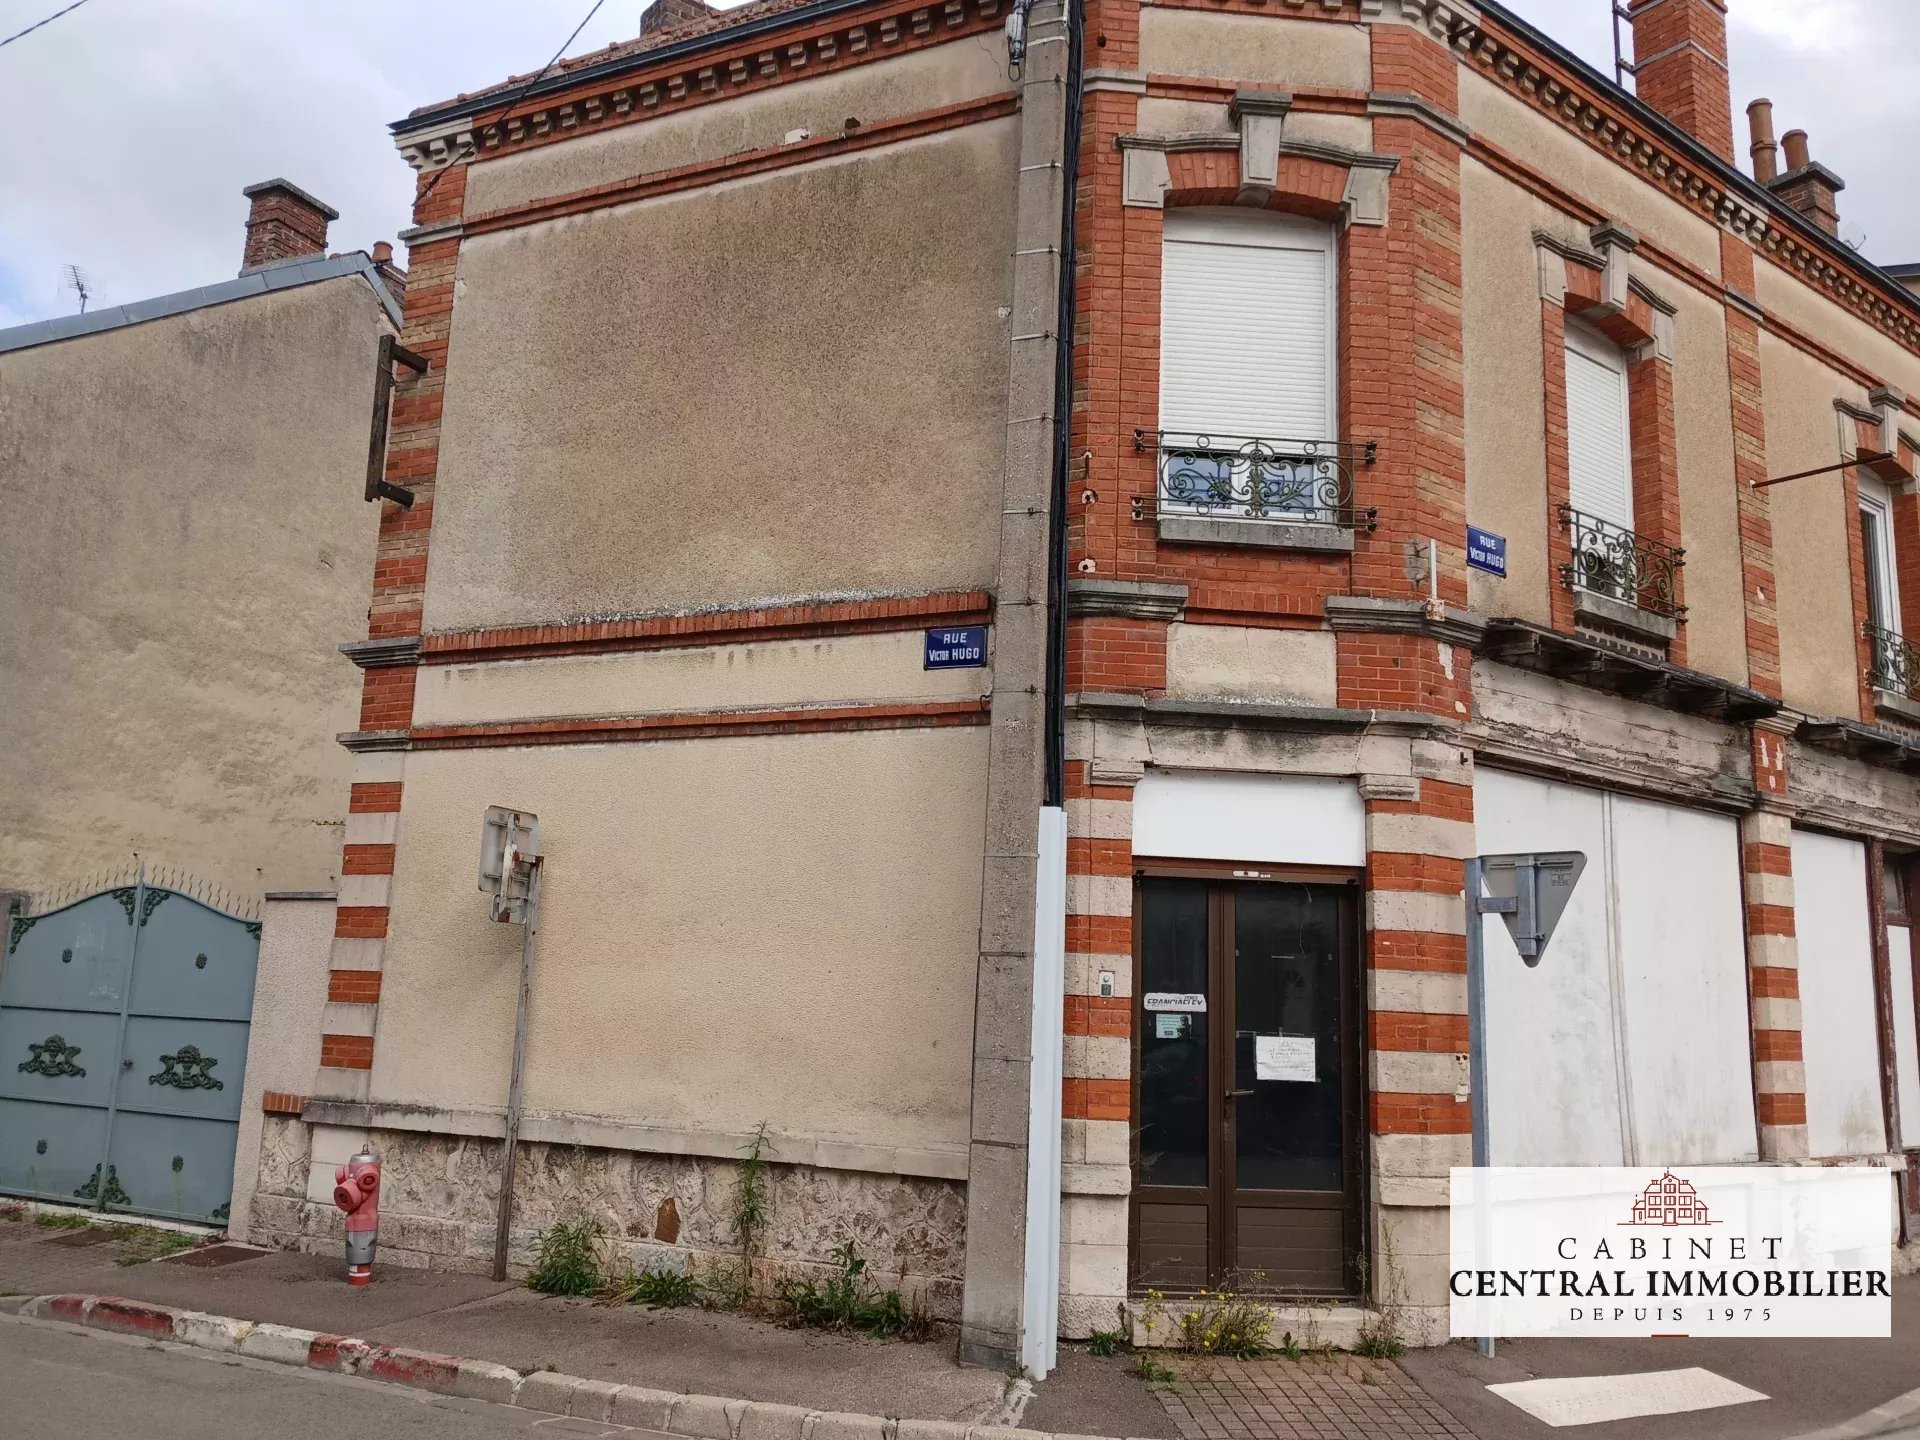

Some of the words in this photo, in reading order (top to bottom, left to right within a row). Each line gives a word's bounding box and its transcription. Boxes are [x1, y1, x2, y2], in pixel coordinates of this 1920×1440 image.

[1480, 536, 1496, 550] RUE
[1486, 552, 1504, 569] HUGO
[943, 632, 968, 644] RUE
[951, 647, 980, 660] HUGO
